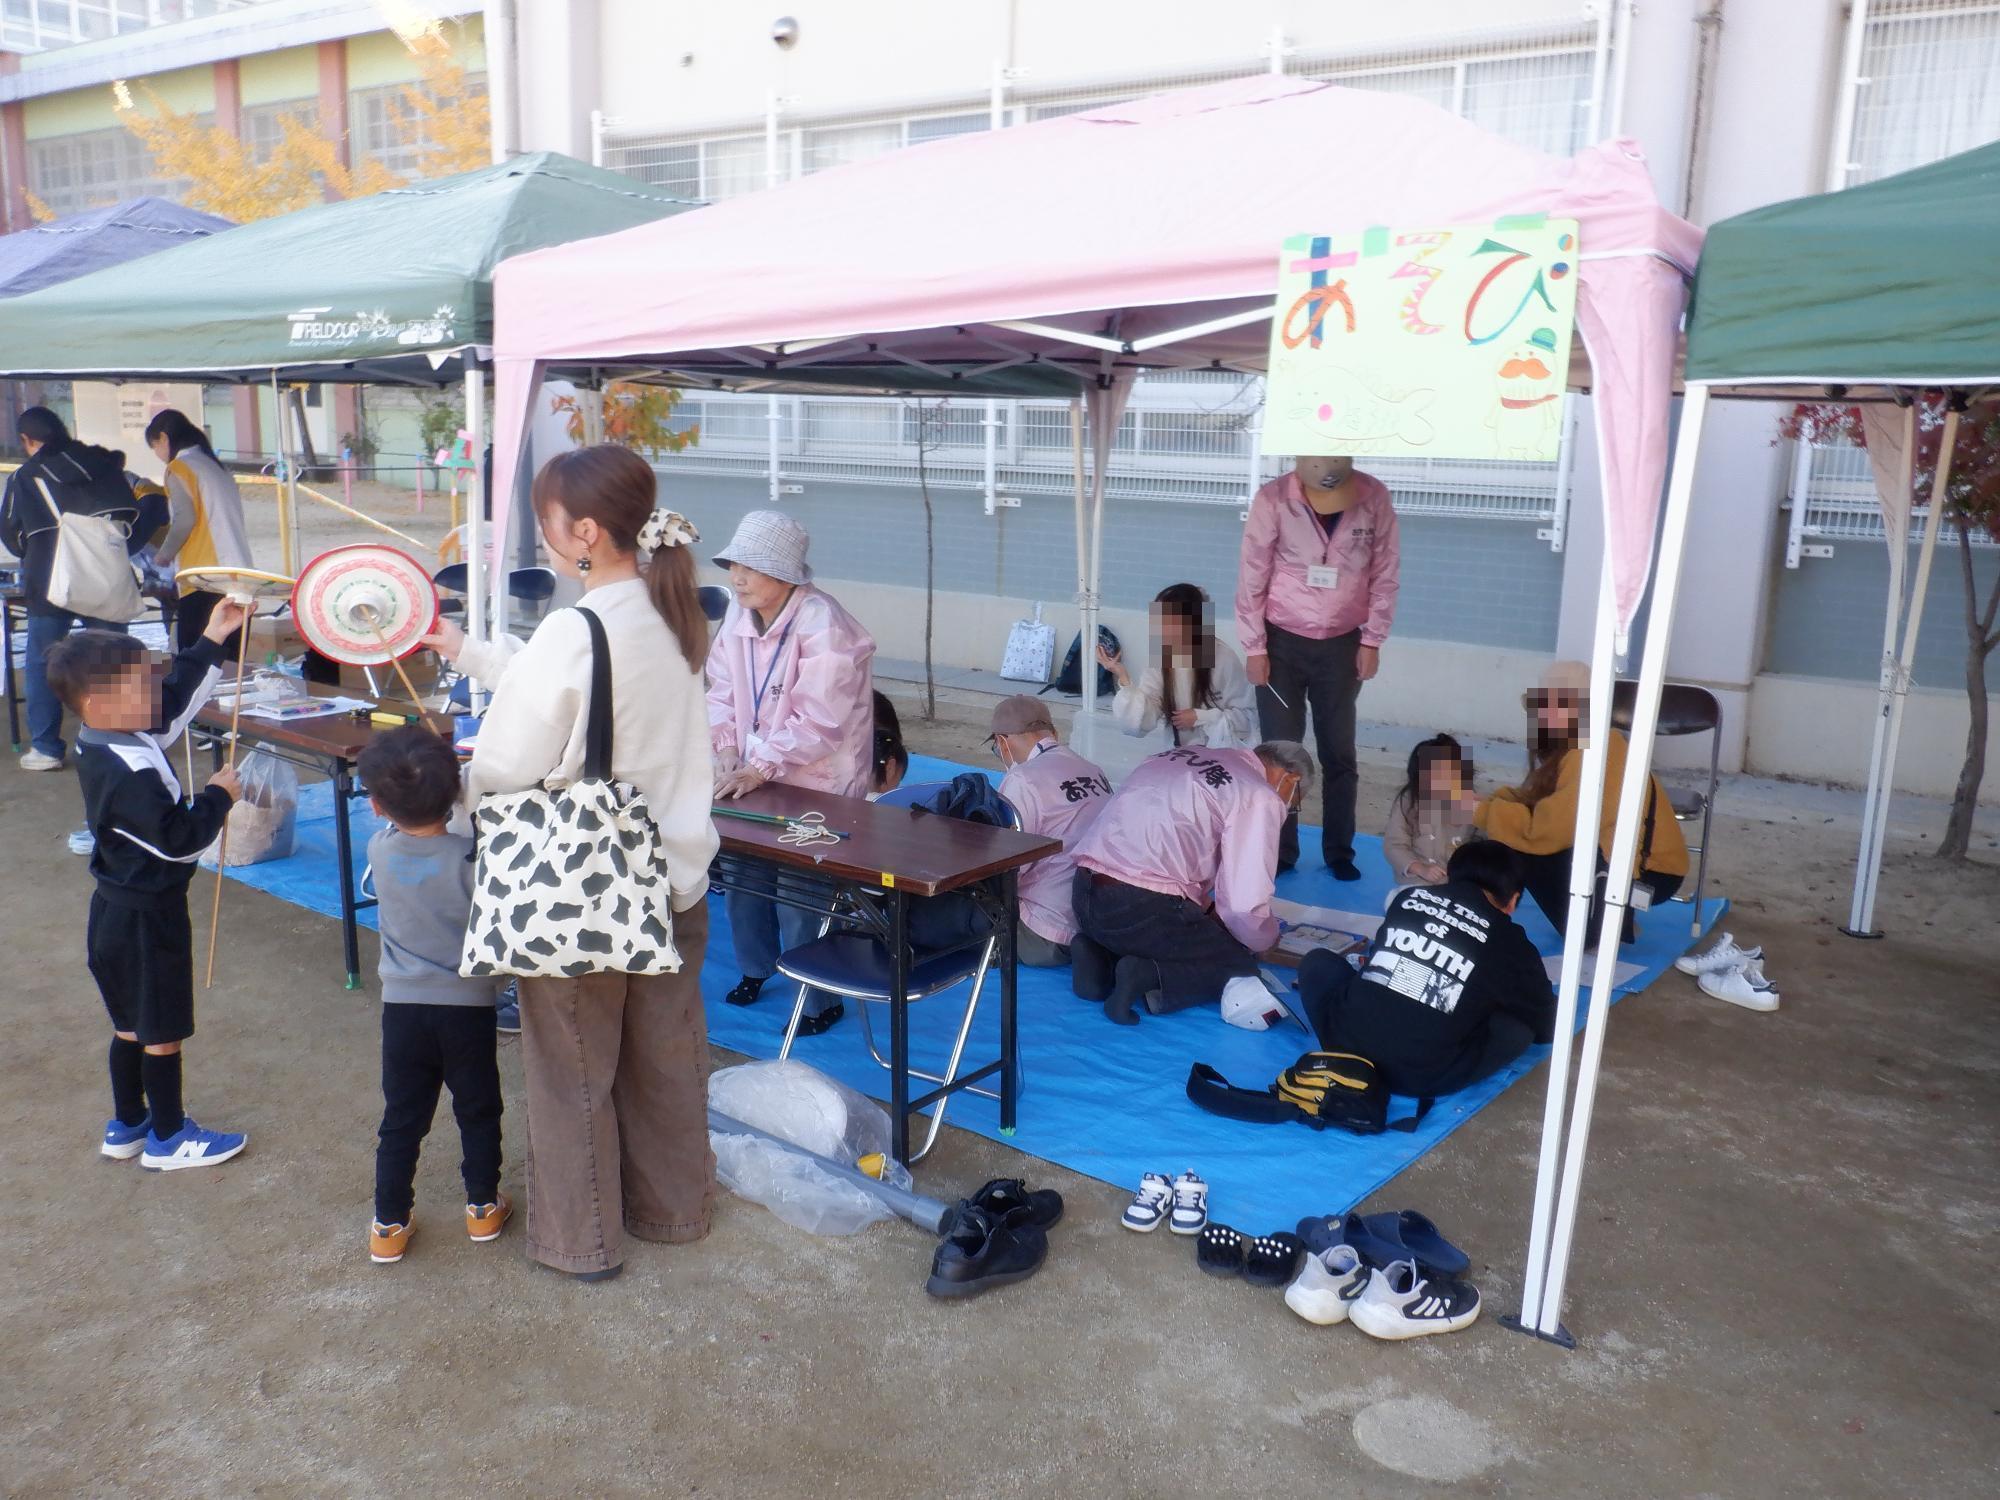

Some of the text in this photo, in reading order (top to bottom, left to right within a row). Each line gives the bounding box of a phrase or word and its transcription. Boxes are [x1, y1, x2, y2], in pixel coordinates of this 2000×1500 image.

[1282, 232, 1573, 350] あそび
[1401, 899, 1488, 943] Coolness
[1410, 888, 1490, 929] Feel The
[1424, 922, 1450, 939] of
[1385, 928, 1475, 982] YOUTH
